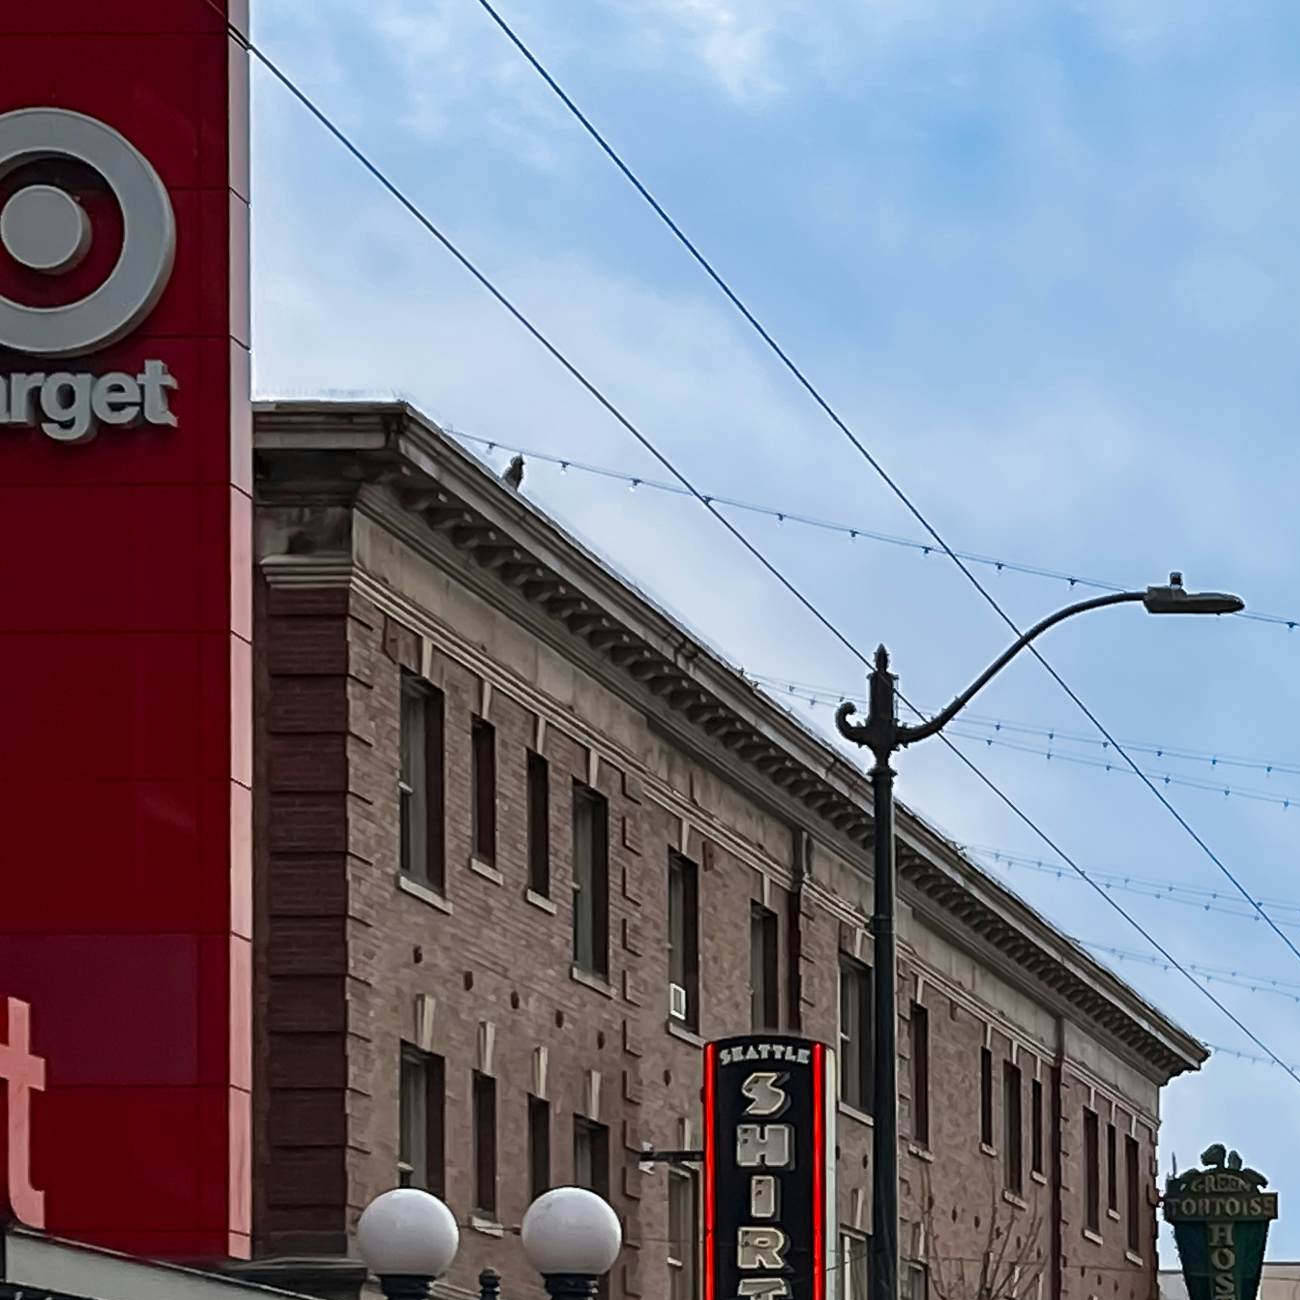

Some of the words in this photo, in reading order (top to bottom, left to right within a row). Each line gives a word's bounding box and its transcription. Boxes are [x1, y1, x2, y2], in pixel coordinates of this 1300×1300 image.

[0, 360, 178, 441] rget
[719, 1043, 811, 1066] SEATTLE
[1190, 1173, 1251, 1194] GREEN
